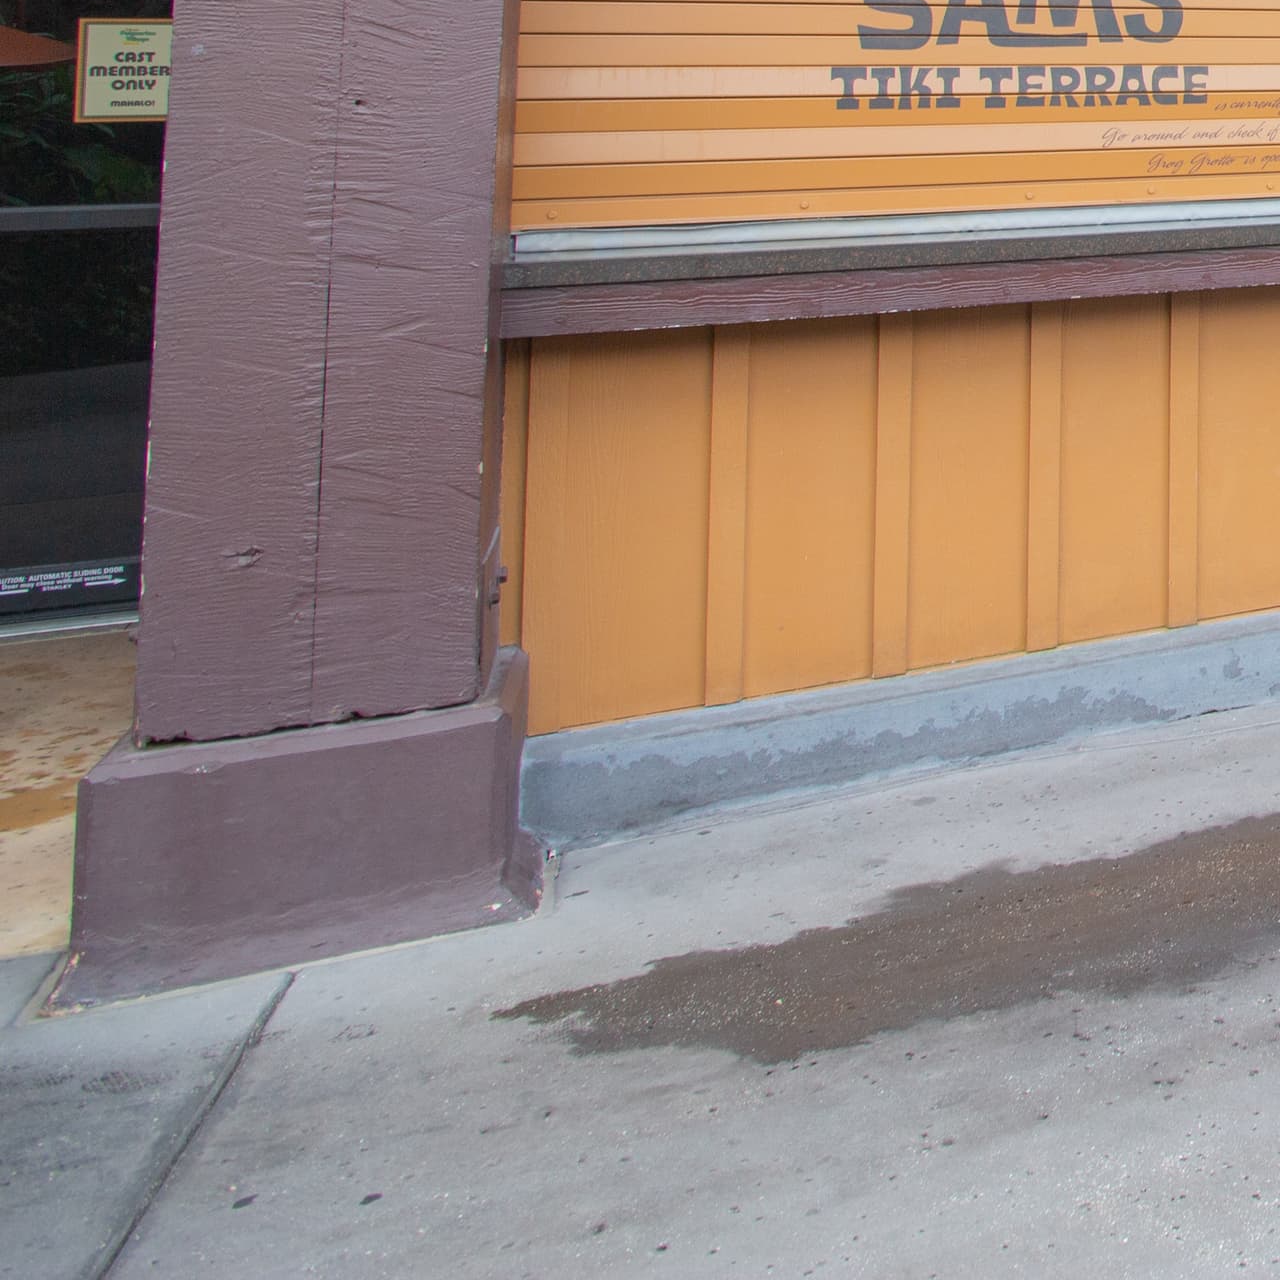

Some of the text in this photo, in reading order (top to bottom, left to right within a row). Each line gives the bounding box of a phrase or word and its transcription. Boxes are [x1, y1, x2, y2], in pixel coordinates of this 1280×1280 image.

[114, 51, 156, 63] CAST
[89, 65, 171, 77] MEMBER
[111, 79, 156, 90] ONLY
[830, 65, 1208, 110] TIKI TERRACE
[110, 100, 155, 108] MAHALO!
[1214, 102, 1227, 112] is
[1101, 127, 1126, 148] Go
[1131, 126, 1191, 143] around
[1192, 125, 1225, 139] and
[1226, 121, 1267, 138] check
[1147, 153, 1185, 174] Grog
[1188, 152, 1236, 174] Grotto
[1243, 155, 1256, 166] is
[0, 565, 124, 586] UTION: AUTOMATIC SLIDING DOOR
[1, 582, 19, 590] Door
[20, 582, 35, 590] may
[56, 576, 82, 585] without
[84, 574, 112, 583] warning
[42, 584, 72, 592] STANLEY
